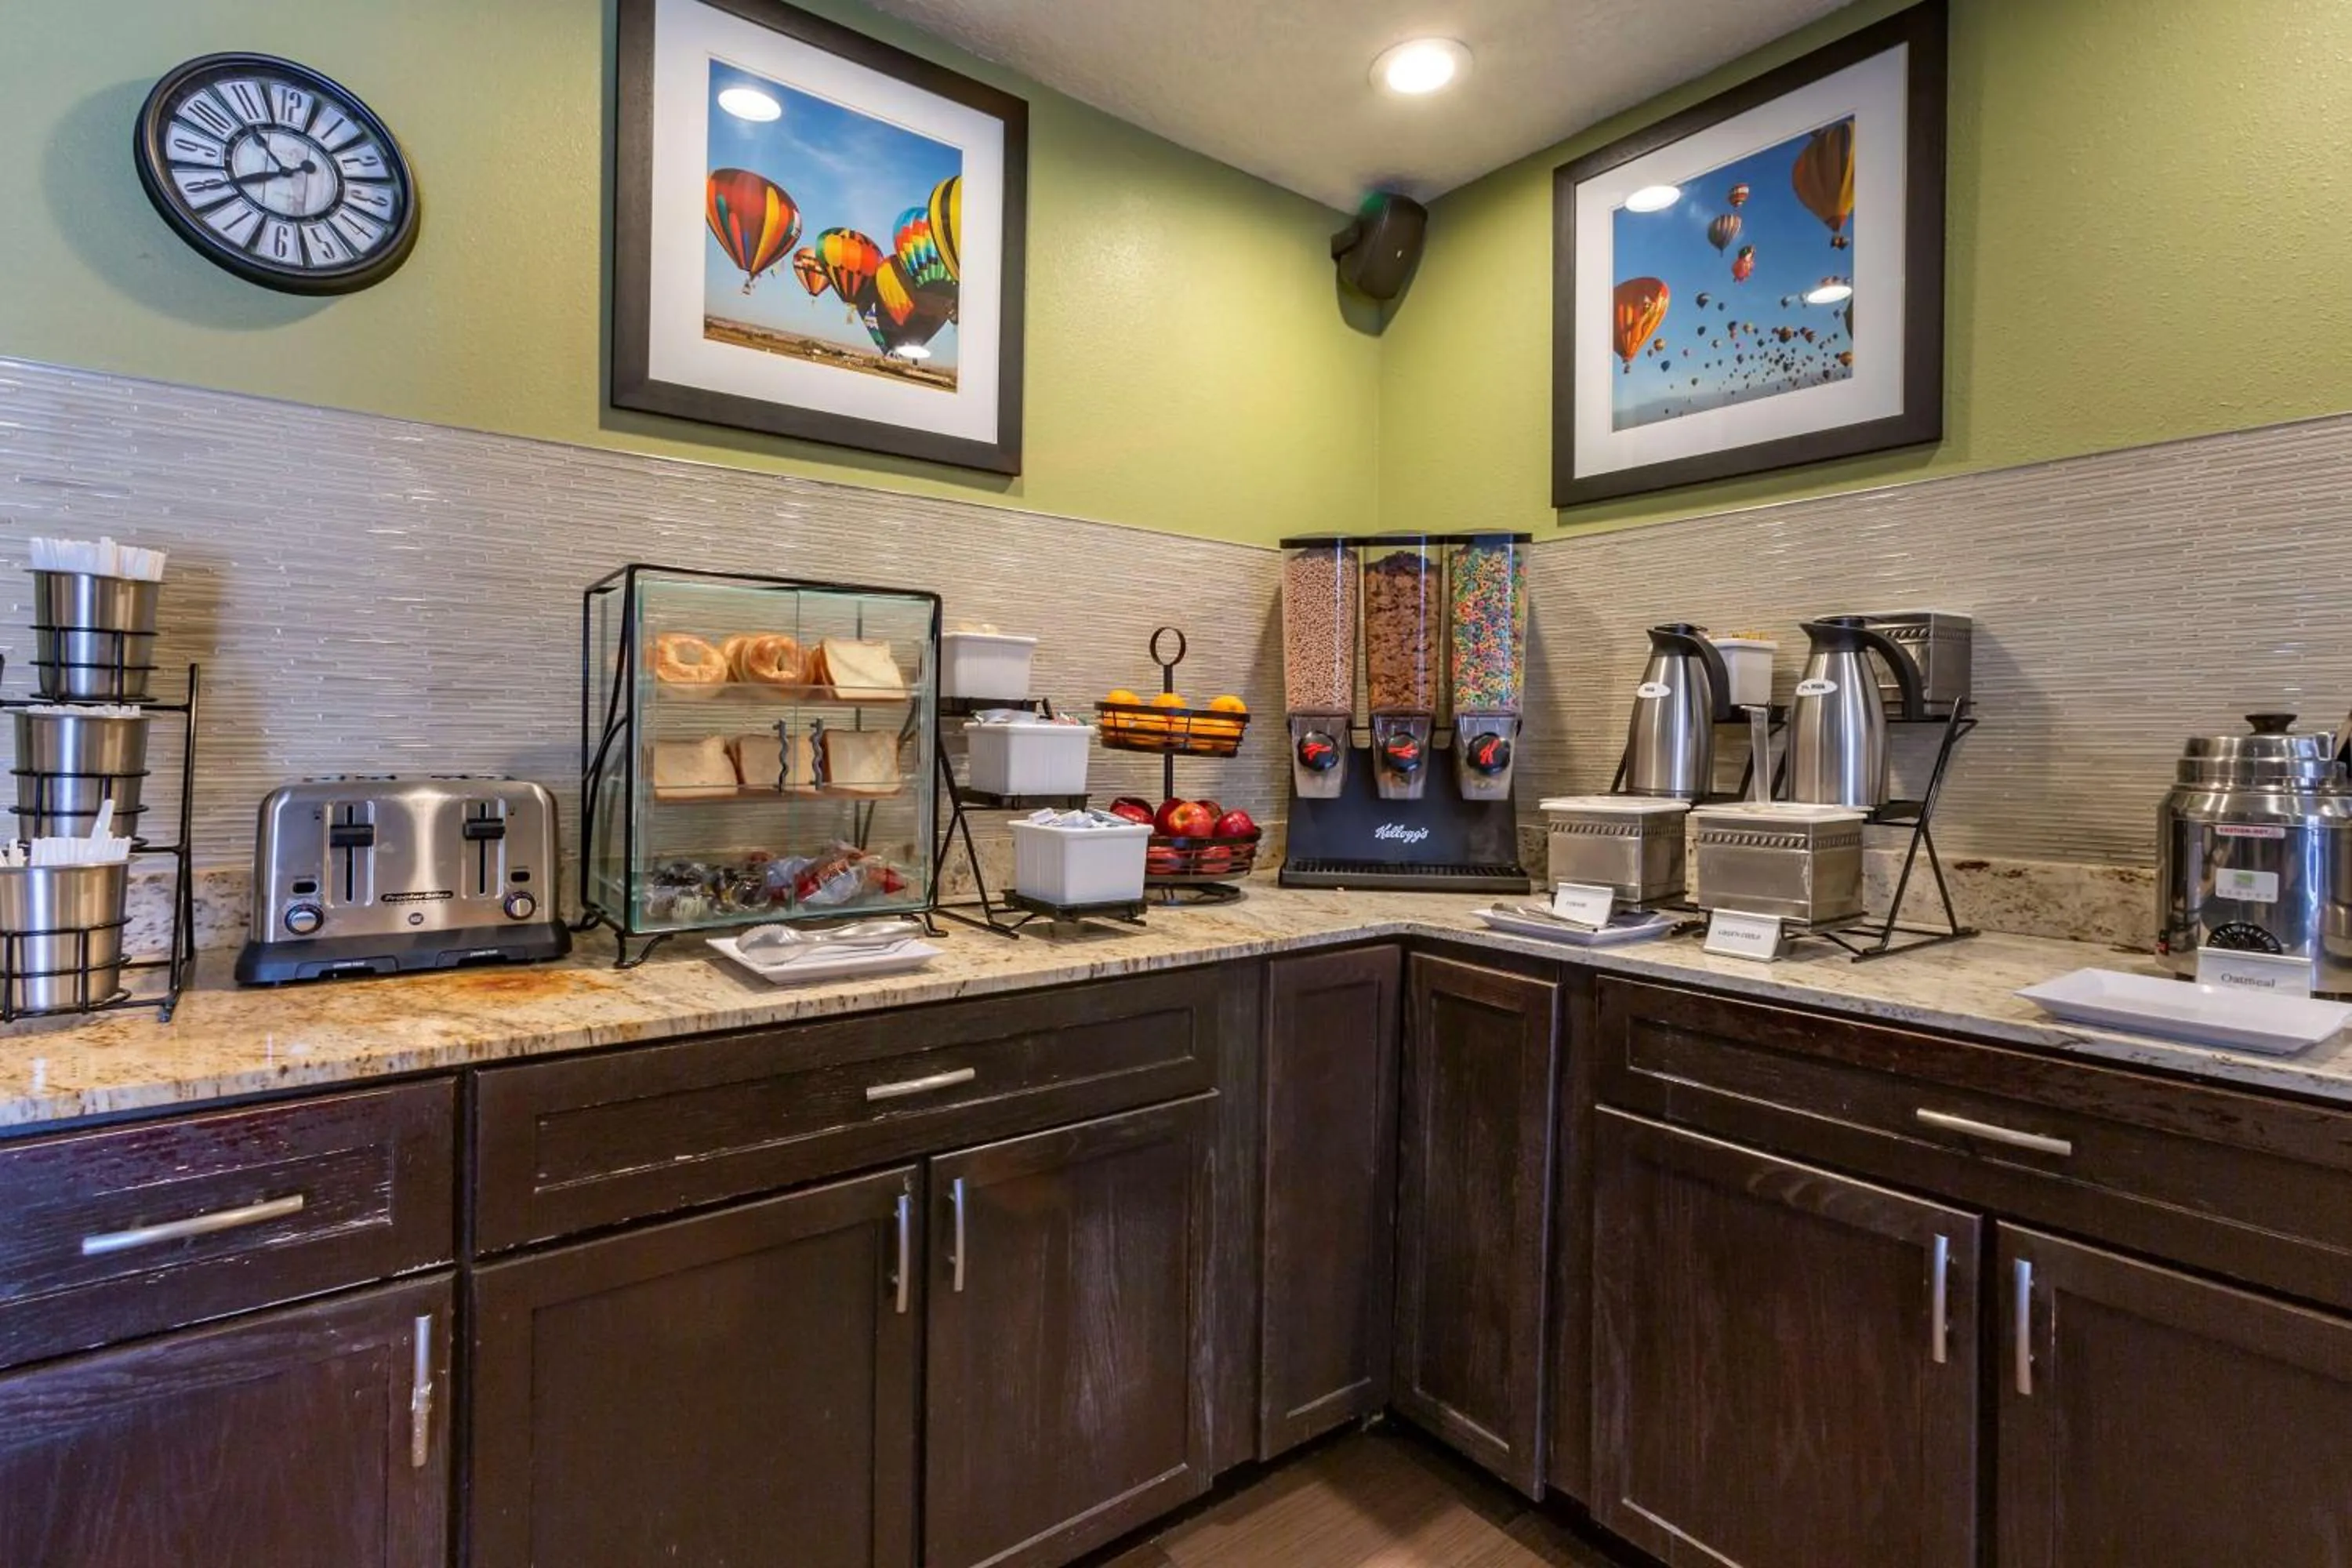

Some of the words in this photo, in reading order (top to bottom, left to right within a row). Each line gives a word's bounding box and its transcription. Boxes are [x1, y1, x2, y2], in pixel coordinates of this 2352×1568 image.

[230, 84, 260, 120] 11
[281, 88, 303, 122] 12
[187, 100, 233, 136] 10
[320, 117, 346, 141] 1
[173, 138, 218, 158] 9
[340, 155, 379, 170] 2
[183, 178, 226, 194] 8
[352, 189, 389, 207] 3
[339, 212, 374, 240] 4
[274, 225, 288, 259] 6
[310, 227, 336, 260] 5
[1375, 822, 1429, 843] Kellogg's
[2220, 972, 2276, 989] Oatmeal
